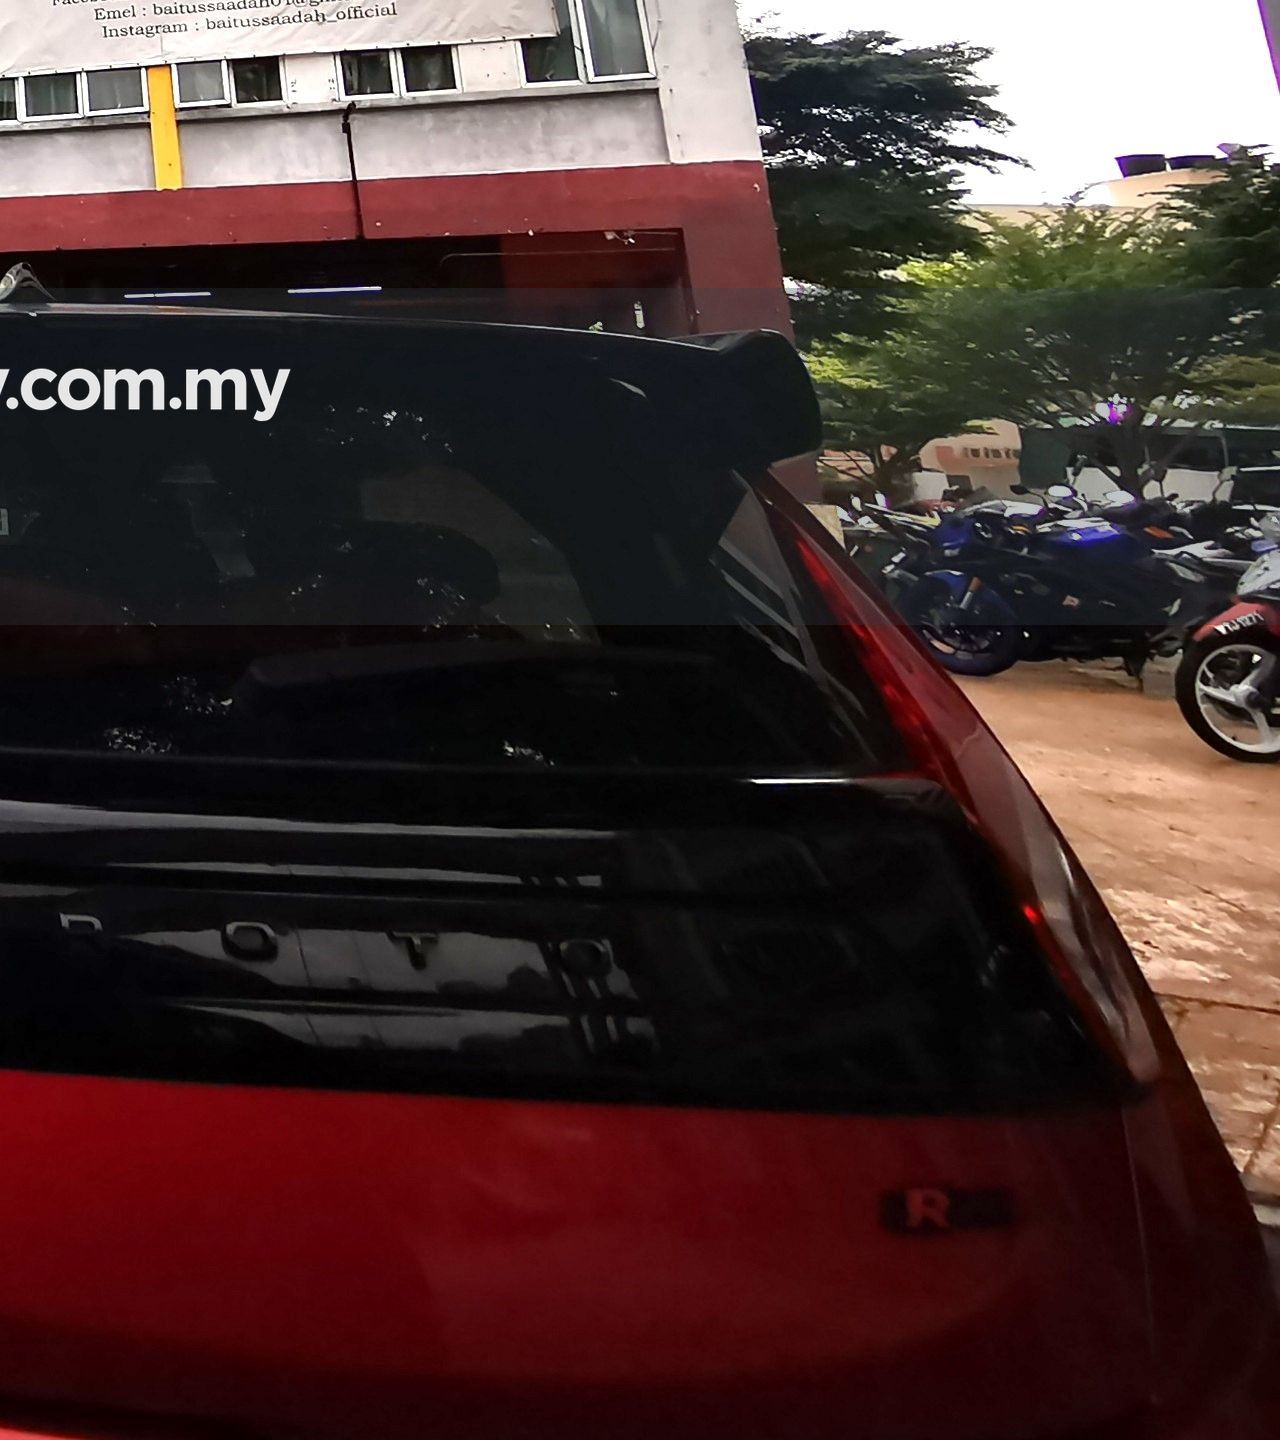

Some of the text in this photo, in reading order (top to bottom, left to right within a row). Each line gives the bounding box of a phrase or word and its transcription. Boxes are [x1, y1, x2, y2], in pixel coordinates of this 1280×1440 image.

[95, 6, 136, 21] Emel
[102, 21, 187, 39] Instagram
[206, 3, 397, 30] baitussaadah_official
